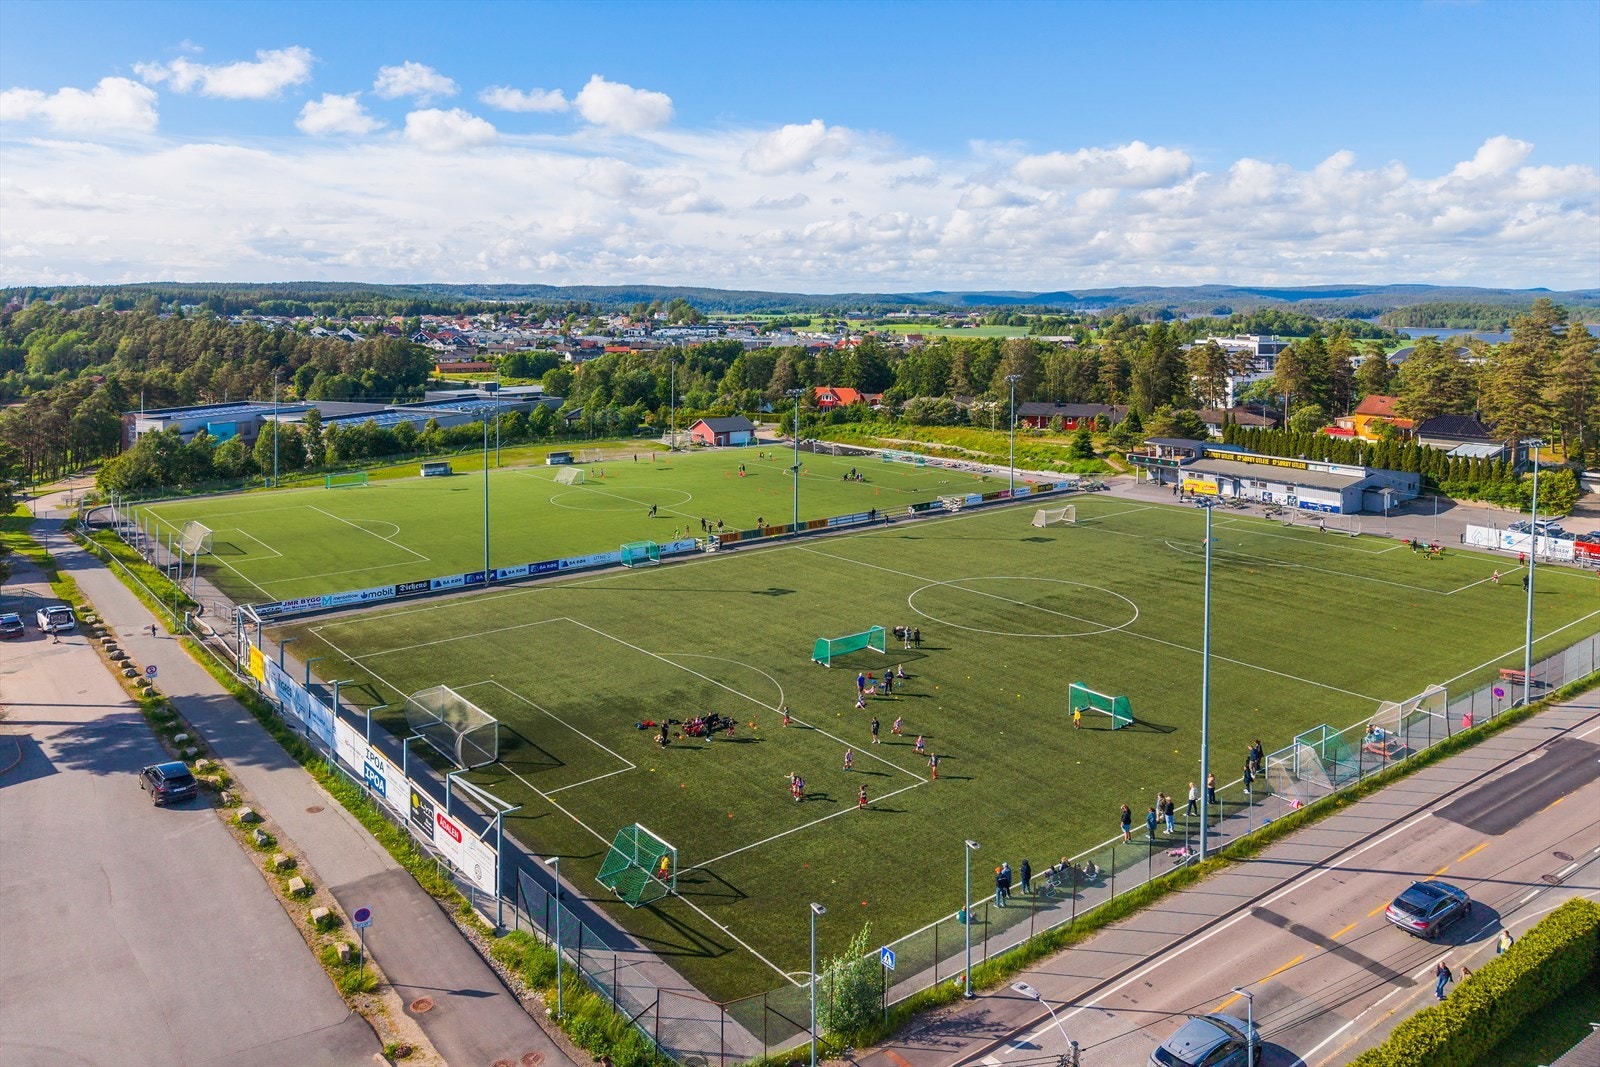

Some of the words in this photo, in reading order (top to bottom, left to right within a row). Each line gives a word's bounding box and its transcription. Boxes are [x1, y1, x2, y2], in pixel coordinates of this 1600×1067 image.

[301, 596, 321, 604] BYGG
[368, 587, 394, 599] mobit
[366, 747, 385, 774] IPOA
[365, 766, 385, 793] IPOA
